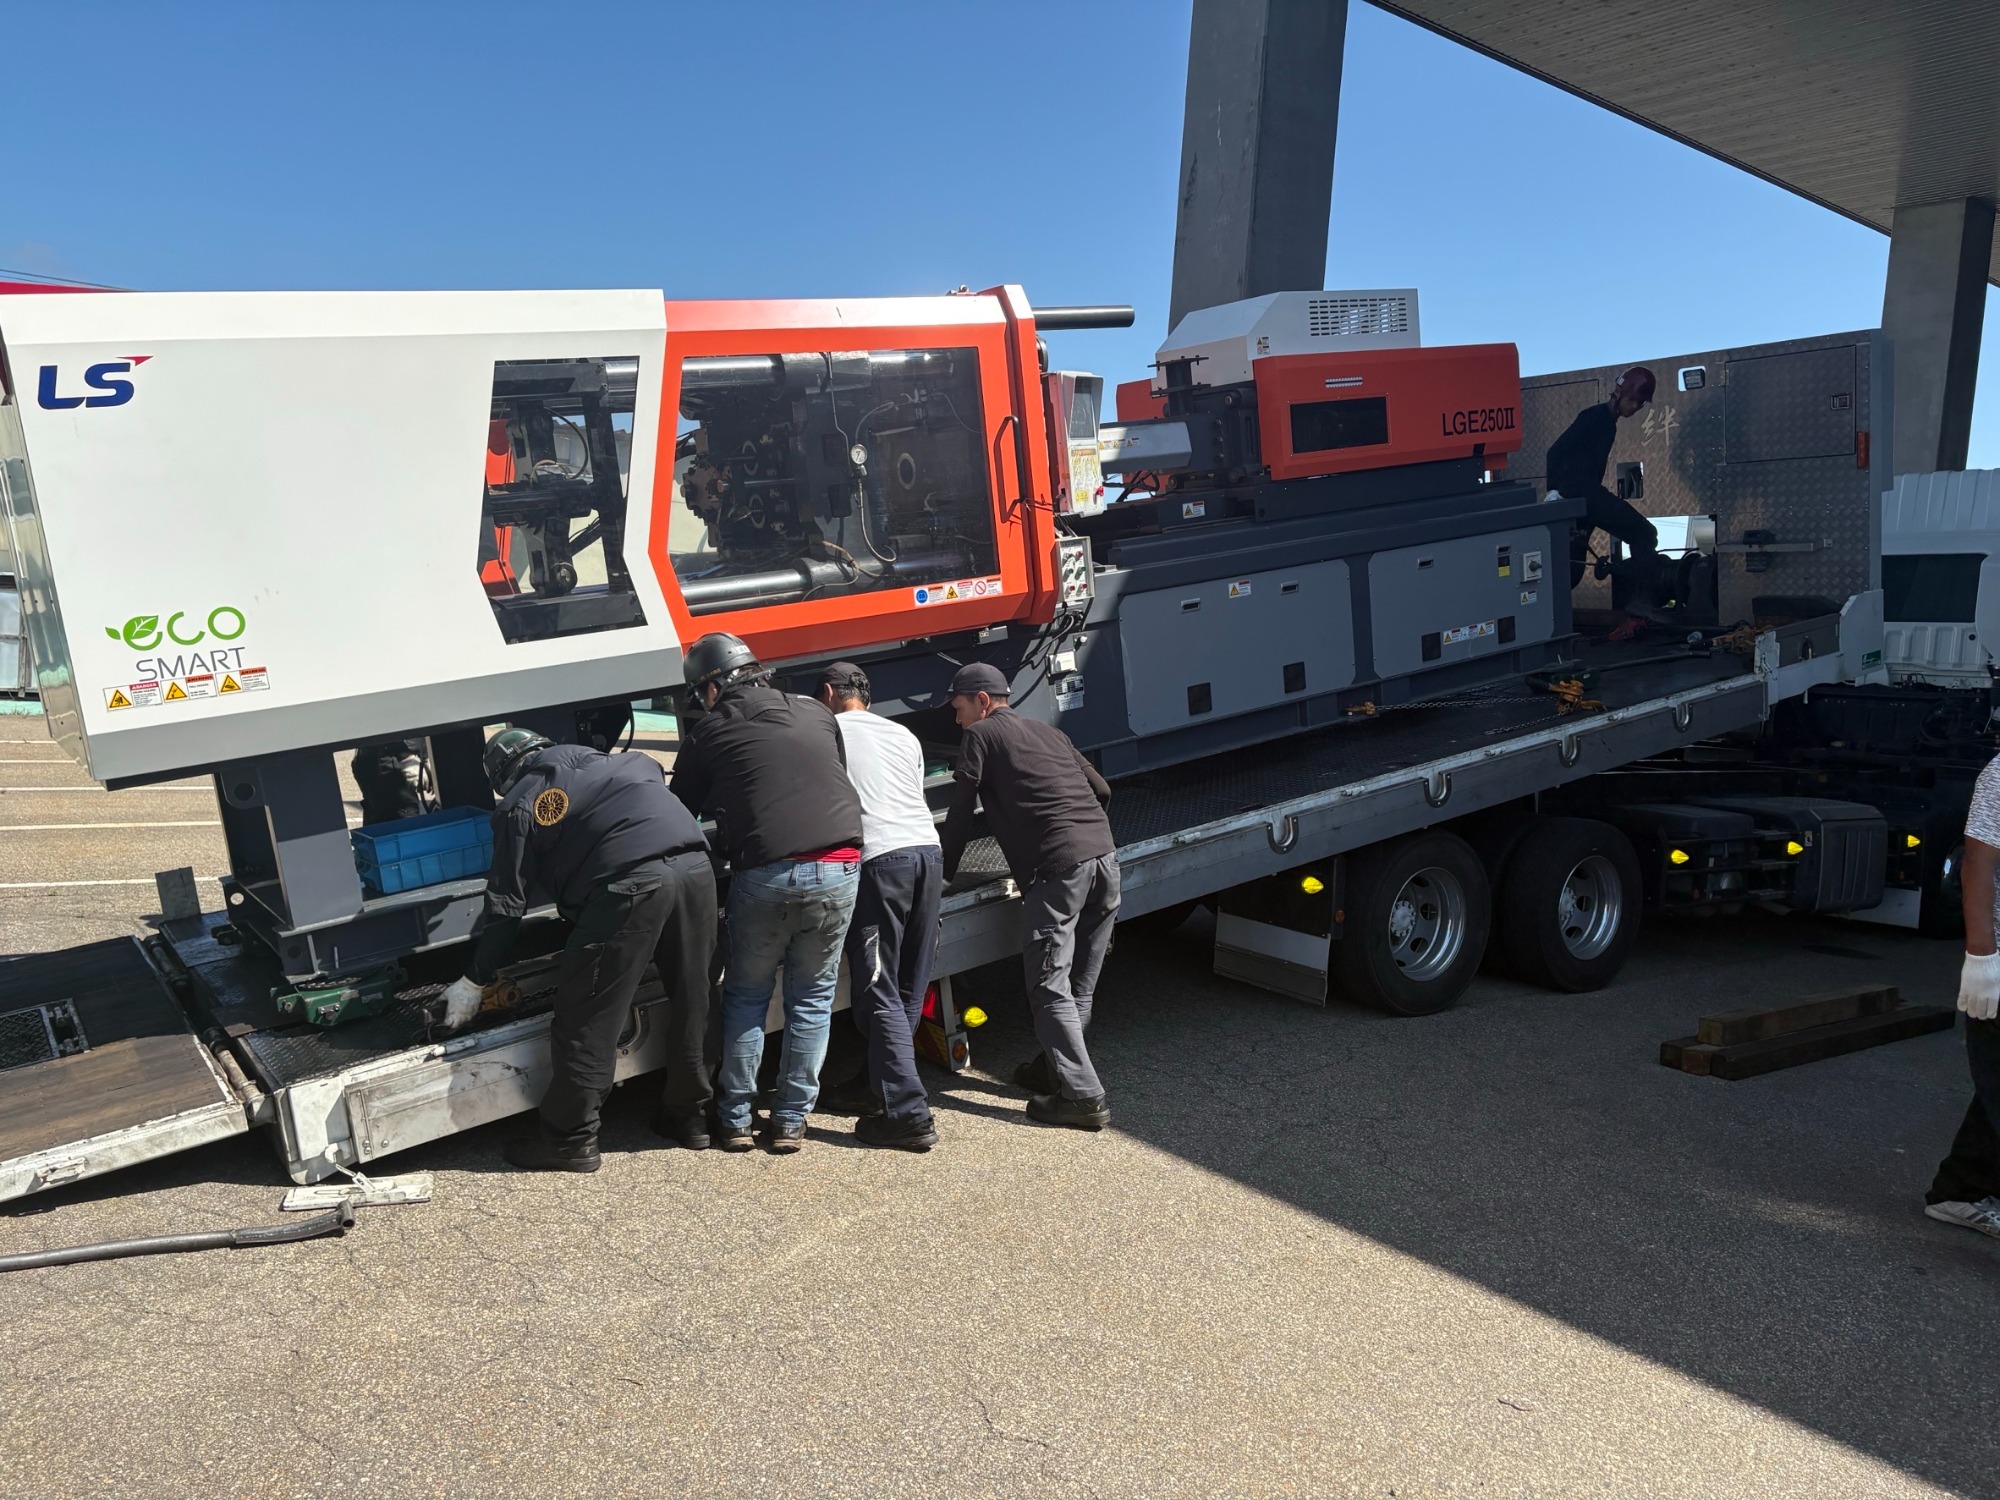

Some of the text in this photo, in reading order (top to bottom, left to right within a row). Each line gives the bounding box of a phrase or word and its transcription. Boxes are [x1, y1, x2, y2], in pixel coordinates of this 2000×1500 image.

[38, 362, 135, 410] LS
[1641, 405, 1680, 447] 絆
[136, 647, 246, 682] SMART
